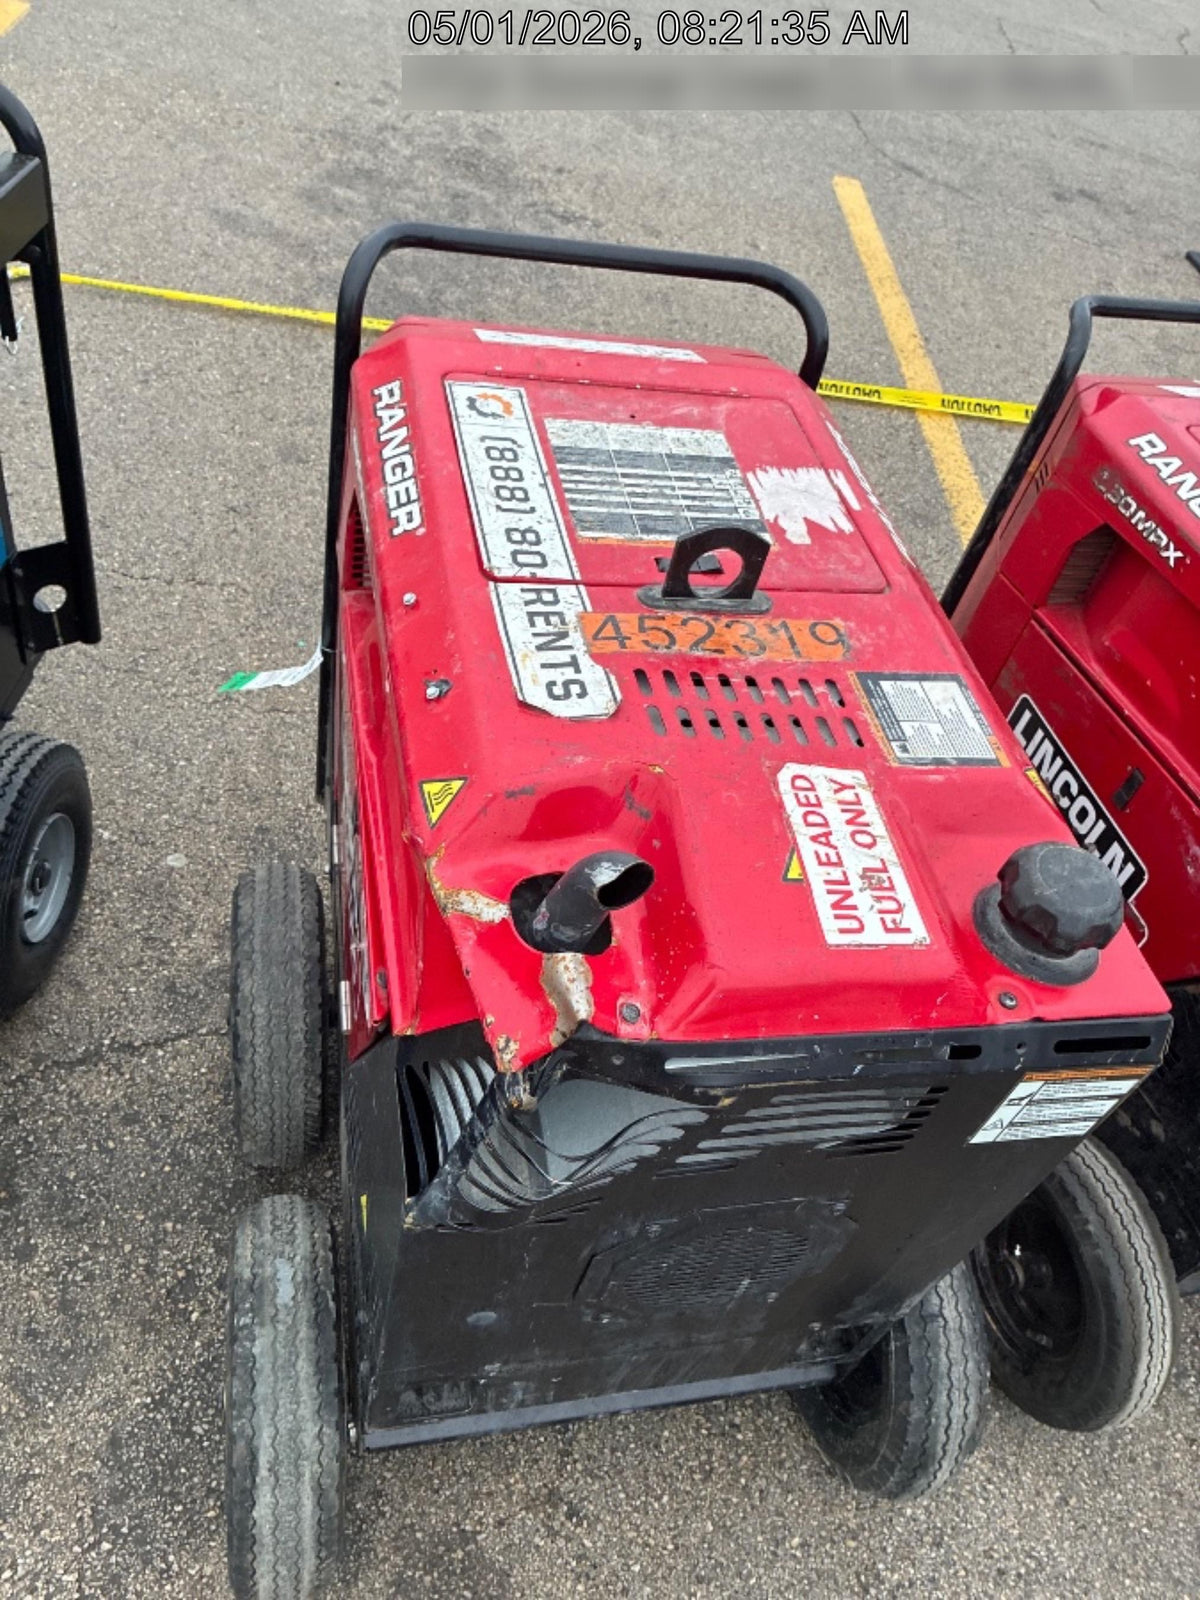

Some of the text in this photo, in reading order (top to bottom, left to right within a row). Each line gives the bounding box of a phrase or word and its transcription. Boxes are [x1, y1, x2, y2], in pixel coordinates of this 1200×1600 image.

[371, 378, 422, 538] RANGER
[479, 434, 588, 701] (888) 80-RENTS
[592, 613, 851, 659] 452319
[790, 774, 865, 935] UNLEADED
[827, 777, 913, 934] FUEL ONLY
